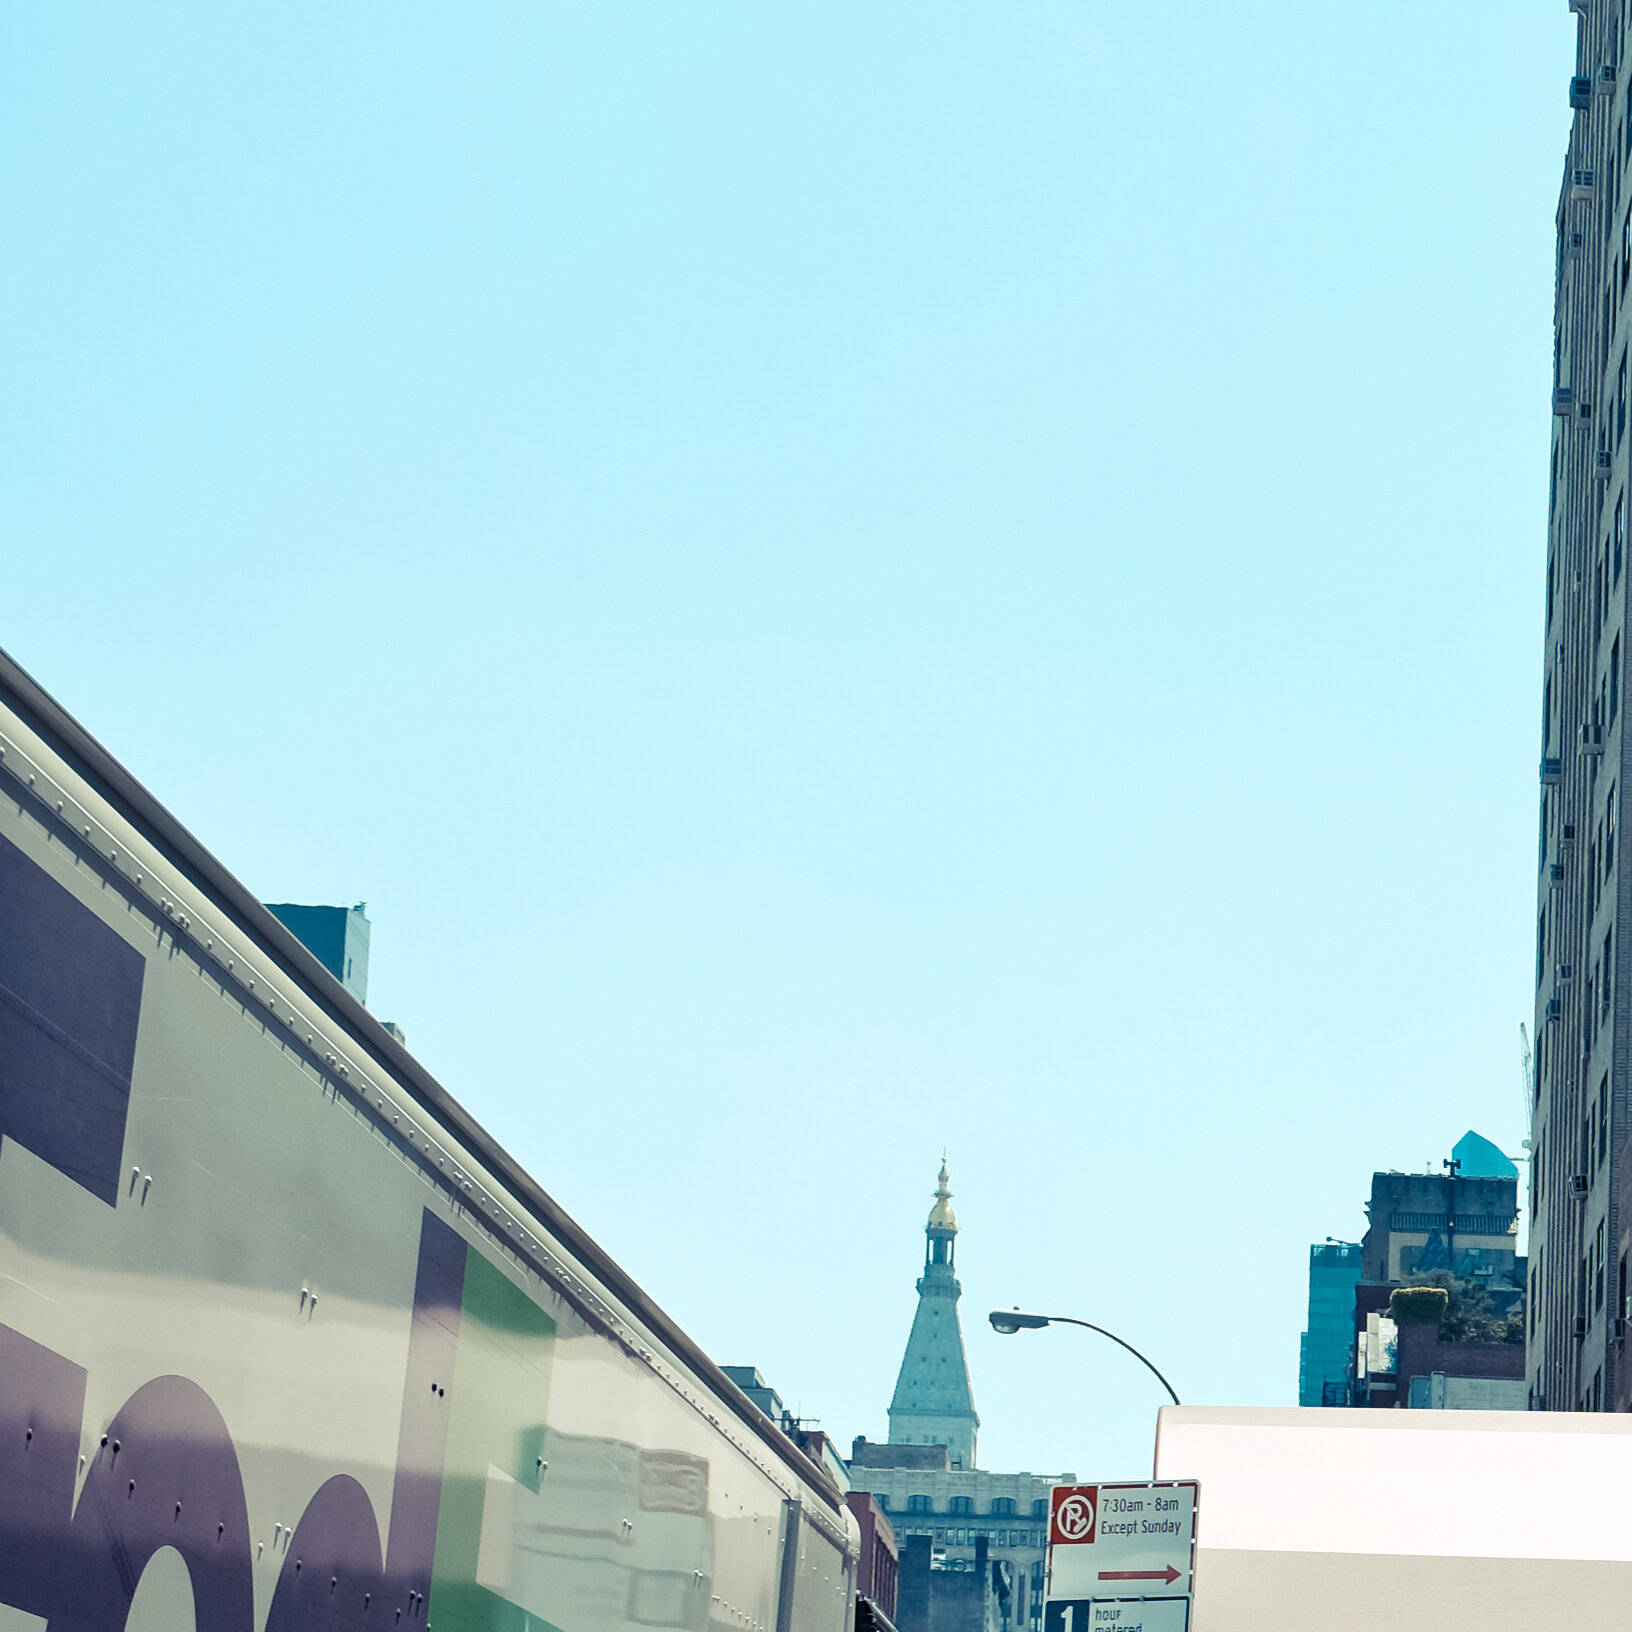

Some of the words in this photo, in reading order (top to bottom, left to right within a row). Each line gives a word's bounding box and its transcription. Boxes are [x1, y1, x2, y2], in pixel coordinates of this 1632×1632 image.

[1102, 1498, 1144, 1514] 7:30am
[1155, 1497, 1179, 1512] 8am
[1101, 1519, 1138, 1536] Except
[1142, 1519, 1182, 1536] Sunday
[1095, 1607, 1122, 1621] hour
